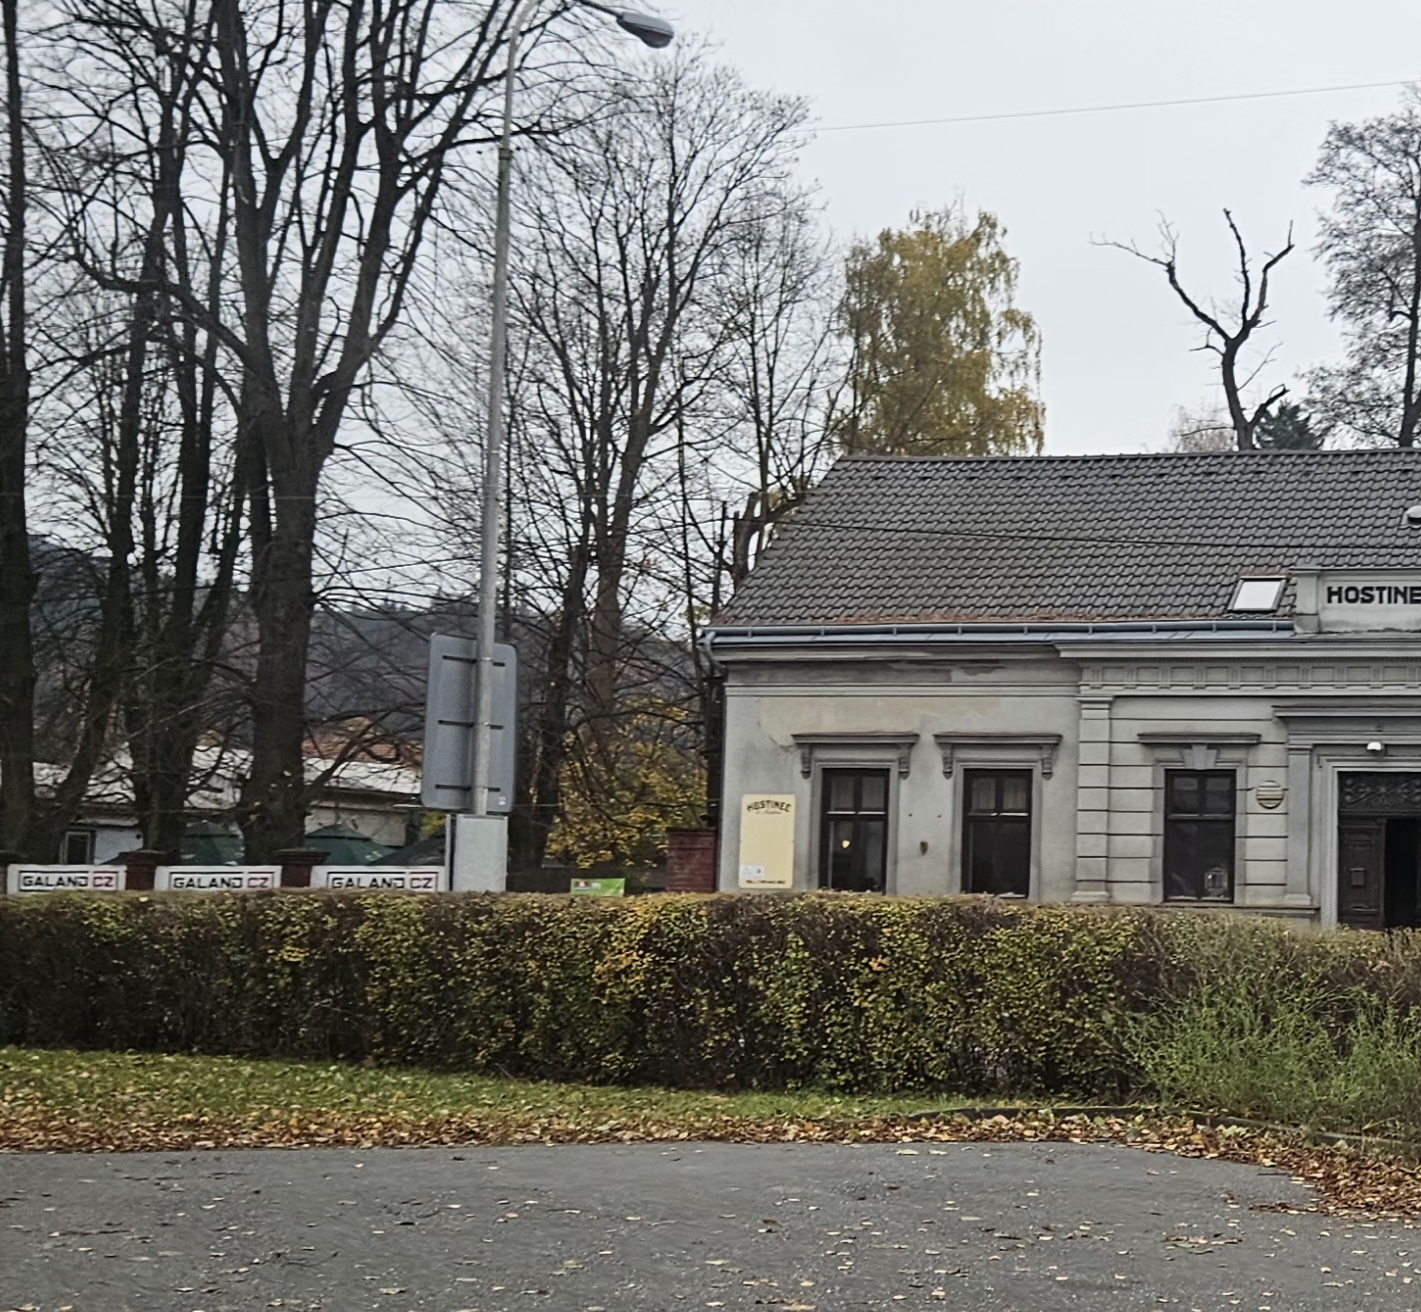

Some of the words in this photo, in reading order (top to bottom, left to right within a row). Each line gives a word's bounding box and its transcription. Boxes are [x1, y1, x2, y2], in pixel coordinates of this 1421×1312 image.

[22, 875, 89, 887] GALAND
[92, 876, 115, 888] CZ
[173, 876, 244, 889] GALAND
[246, 877, 269, 889] CZ
[331, 876, 405, 890] GALAND
[409, 877, 434, 890] CZ
